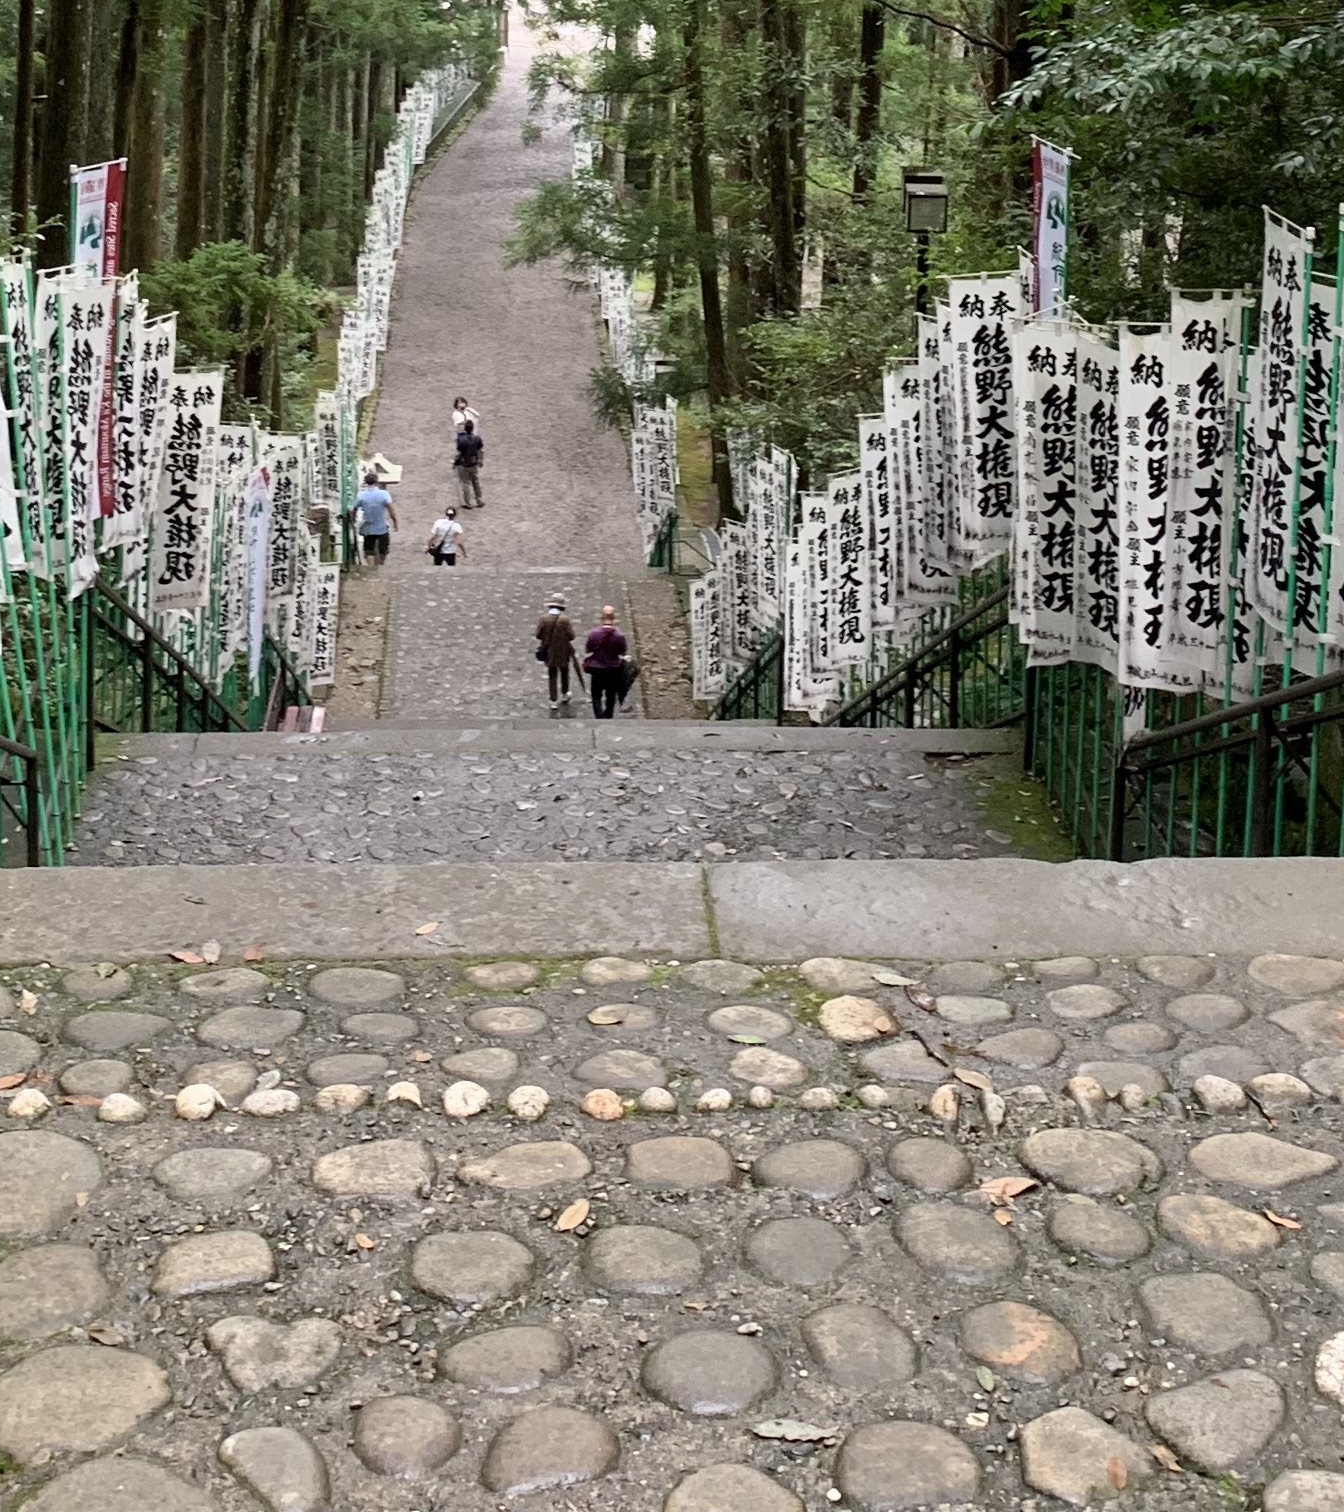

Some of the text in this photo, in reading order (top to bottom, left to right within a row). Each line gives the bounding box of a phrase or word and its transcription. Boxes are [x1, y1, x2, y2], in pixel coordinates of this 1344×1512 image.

[958, 290, 1016, 322] 奉納
[972, 323, 1015, 519] 熊野大権現
[1124, 416, 1141, 447] 願意
[1174, 383, 1191, 416] 願意
[1261, 296, 1294, 592] 熊野大権現
[1040, 384, 1077, 615] 熊野大権現
[1088, 399, 1120, 644] 熊野大権現
[1170, 510, 1188, 540] 願主
[838, 508, 866, 645] 熊野大権現
[1126, 538, 1142, 566] 願主
